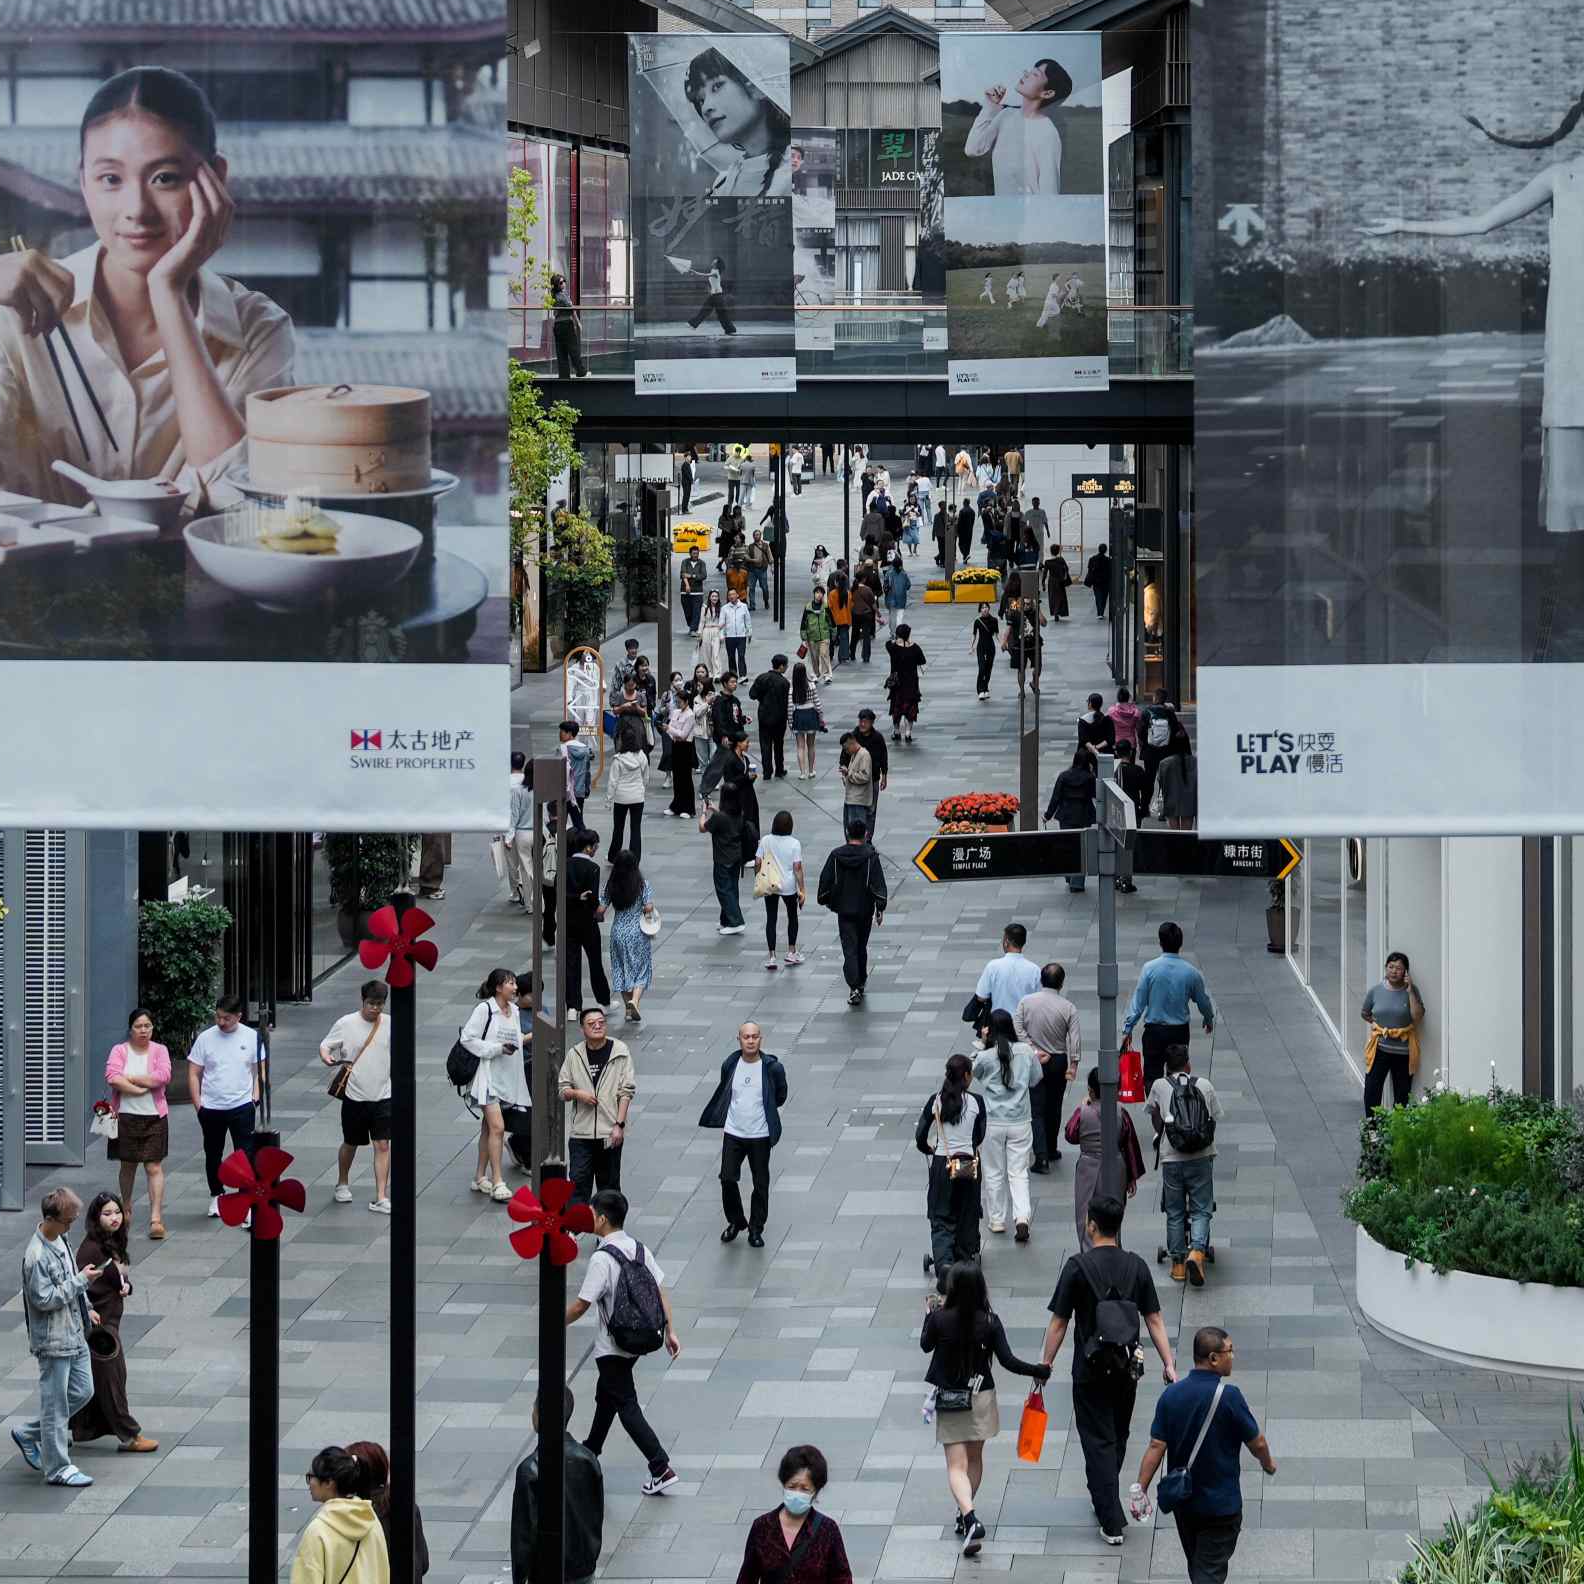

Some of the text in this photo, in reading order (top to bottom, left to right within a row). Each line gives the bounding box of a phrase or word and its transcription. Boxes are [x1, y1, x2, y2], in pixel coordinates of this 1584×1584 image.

[881, 171, 905, 183] JADE
[388, 729, 475, 751] 太古地产
[1236, 730, 1294, 752] LET'S
[350, 755, 476, 770] SWIRE PROPERTIES
[1241, 754, 1301, 774] PLAY
[952, 846, 991, 862] 漫广场
